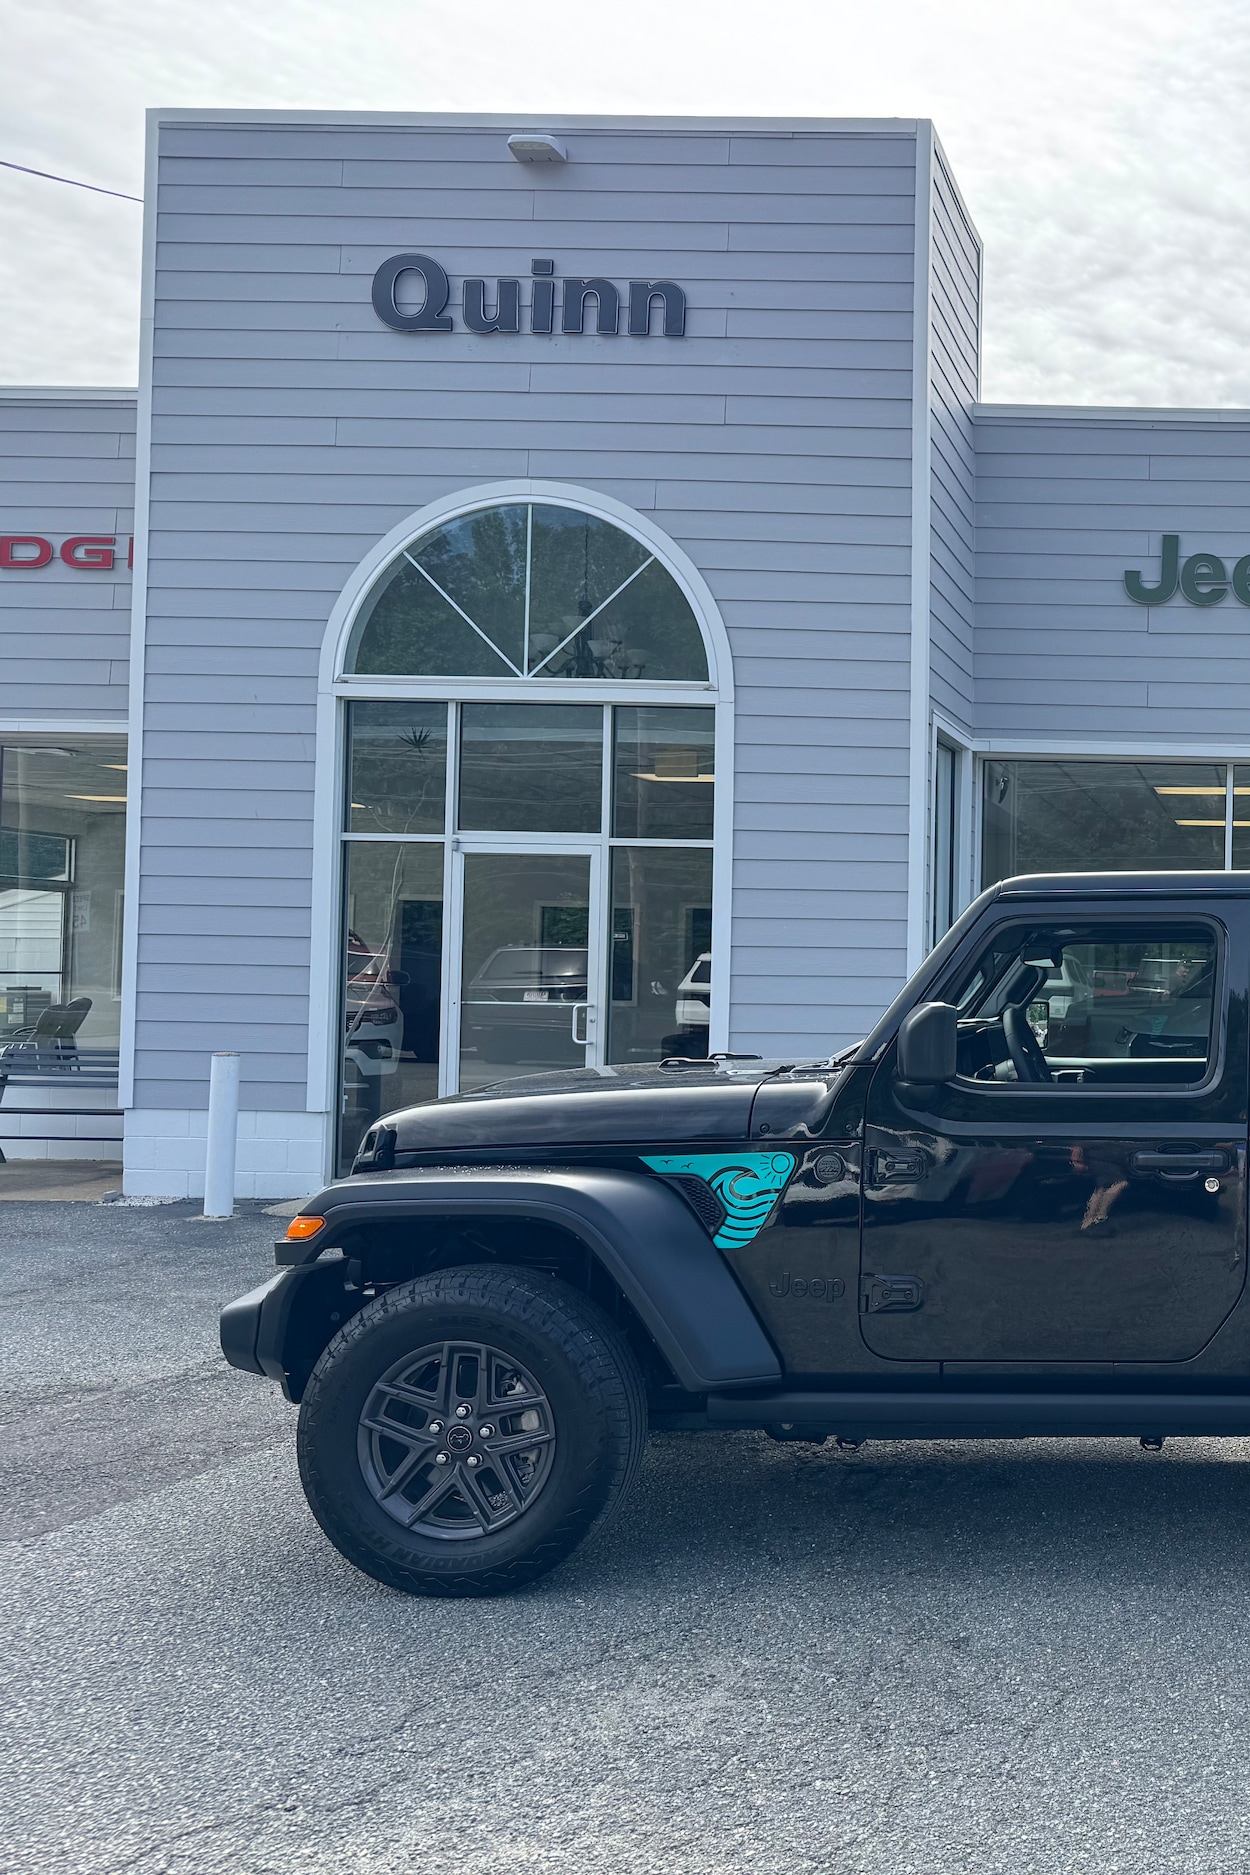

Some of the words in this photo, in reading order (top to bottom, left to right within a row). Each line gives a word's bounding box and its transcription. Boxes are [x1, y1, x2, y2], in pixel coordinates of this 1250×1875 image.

[371, 252, 687, 336] Quinn
[0, 535, 133, 569] DG
[769, 1271, 846, 1302] Jeep
[436, 1314, 545, 1361] NEXEN
